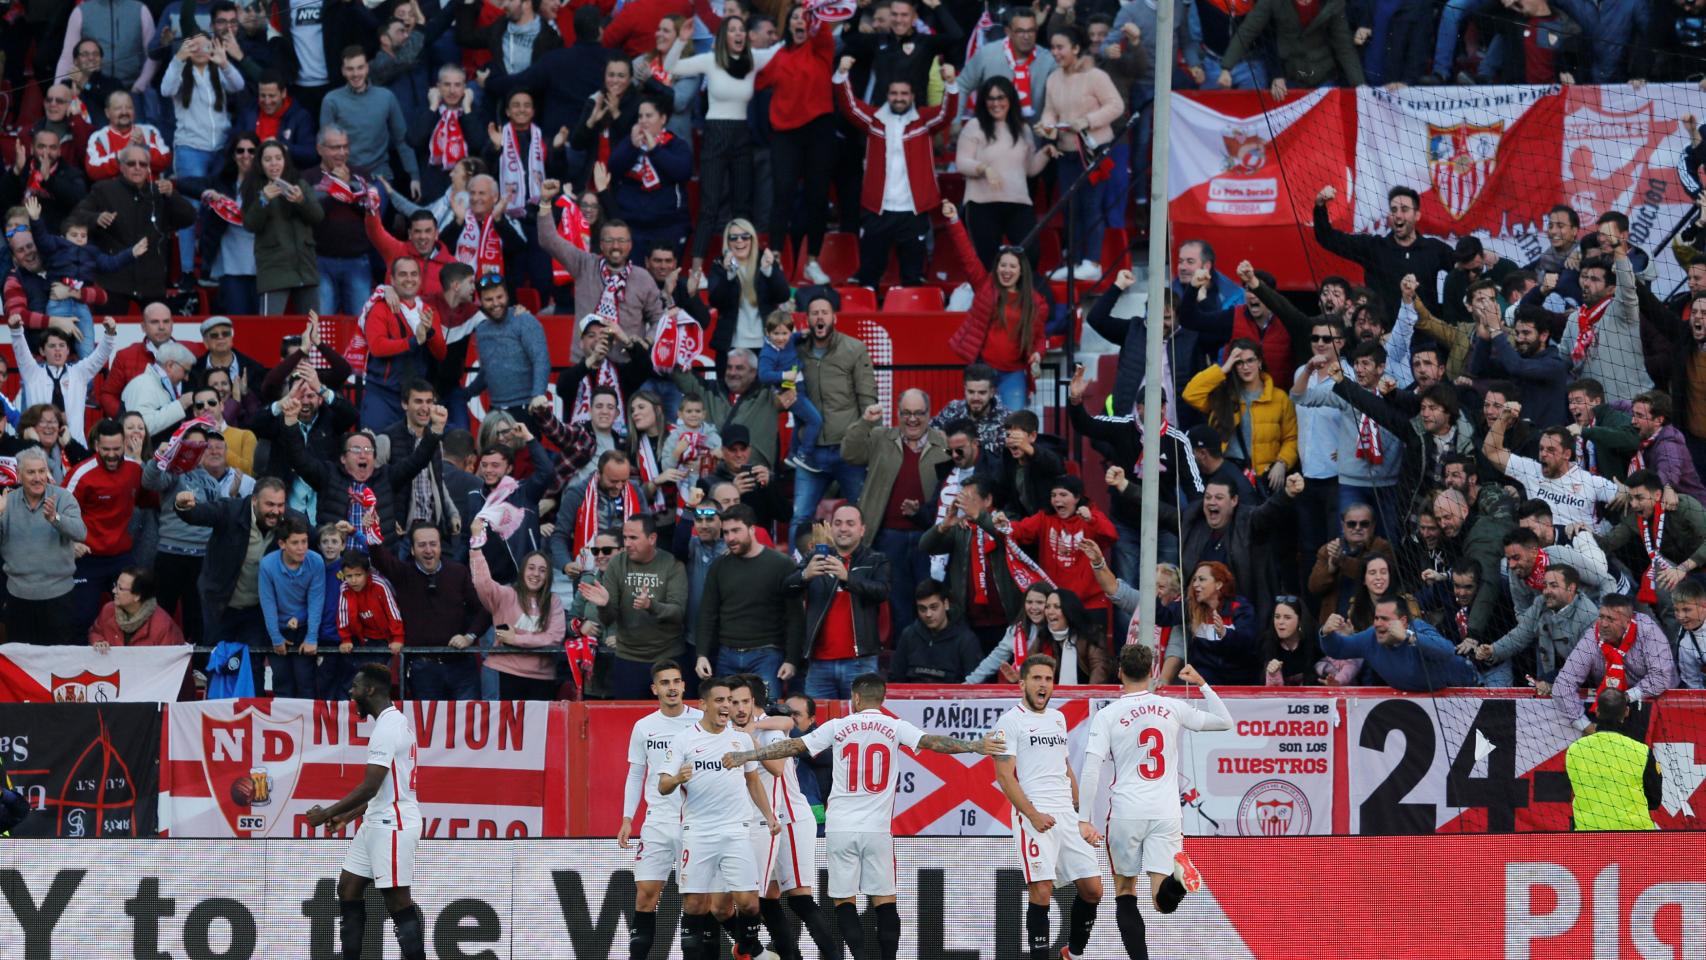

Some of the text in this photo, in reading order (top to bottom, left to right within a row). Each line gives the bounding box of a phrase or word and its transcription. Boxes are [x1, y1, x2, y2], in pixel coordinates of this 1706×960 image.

[298, 8, 321, 20] NYC
[1536, 488, 1586, 508] Playtika
[1287, 704, 1310, 714] LOS
[313, 699, 525, 751] NEVION
[834, 721, 896, 743] EVER BANEGA
[212, 728, 295, 762] N D
[1137, 727, 1166, 781] 3
[1306, 743, 1328, 752] LOS
[694, 760, 723, 772] Play
[841, 742, 891, 794] 10
[240, 818, 263, 829] SFC
[960, 808, 977, 826] 16
[1028, 837, 1040, 858] 6
[682, 849, 690, 868] 9
[124, 876, 257, 960] to
